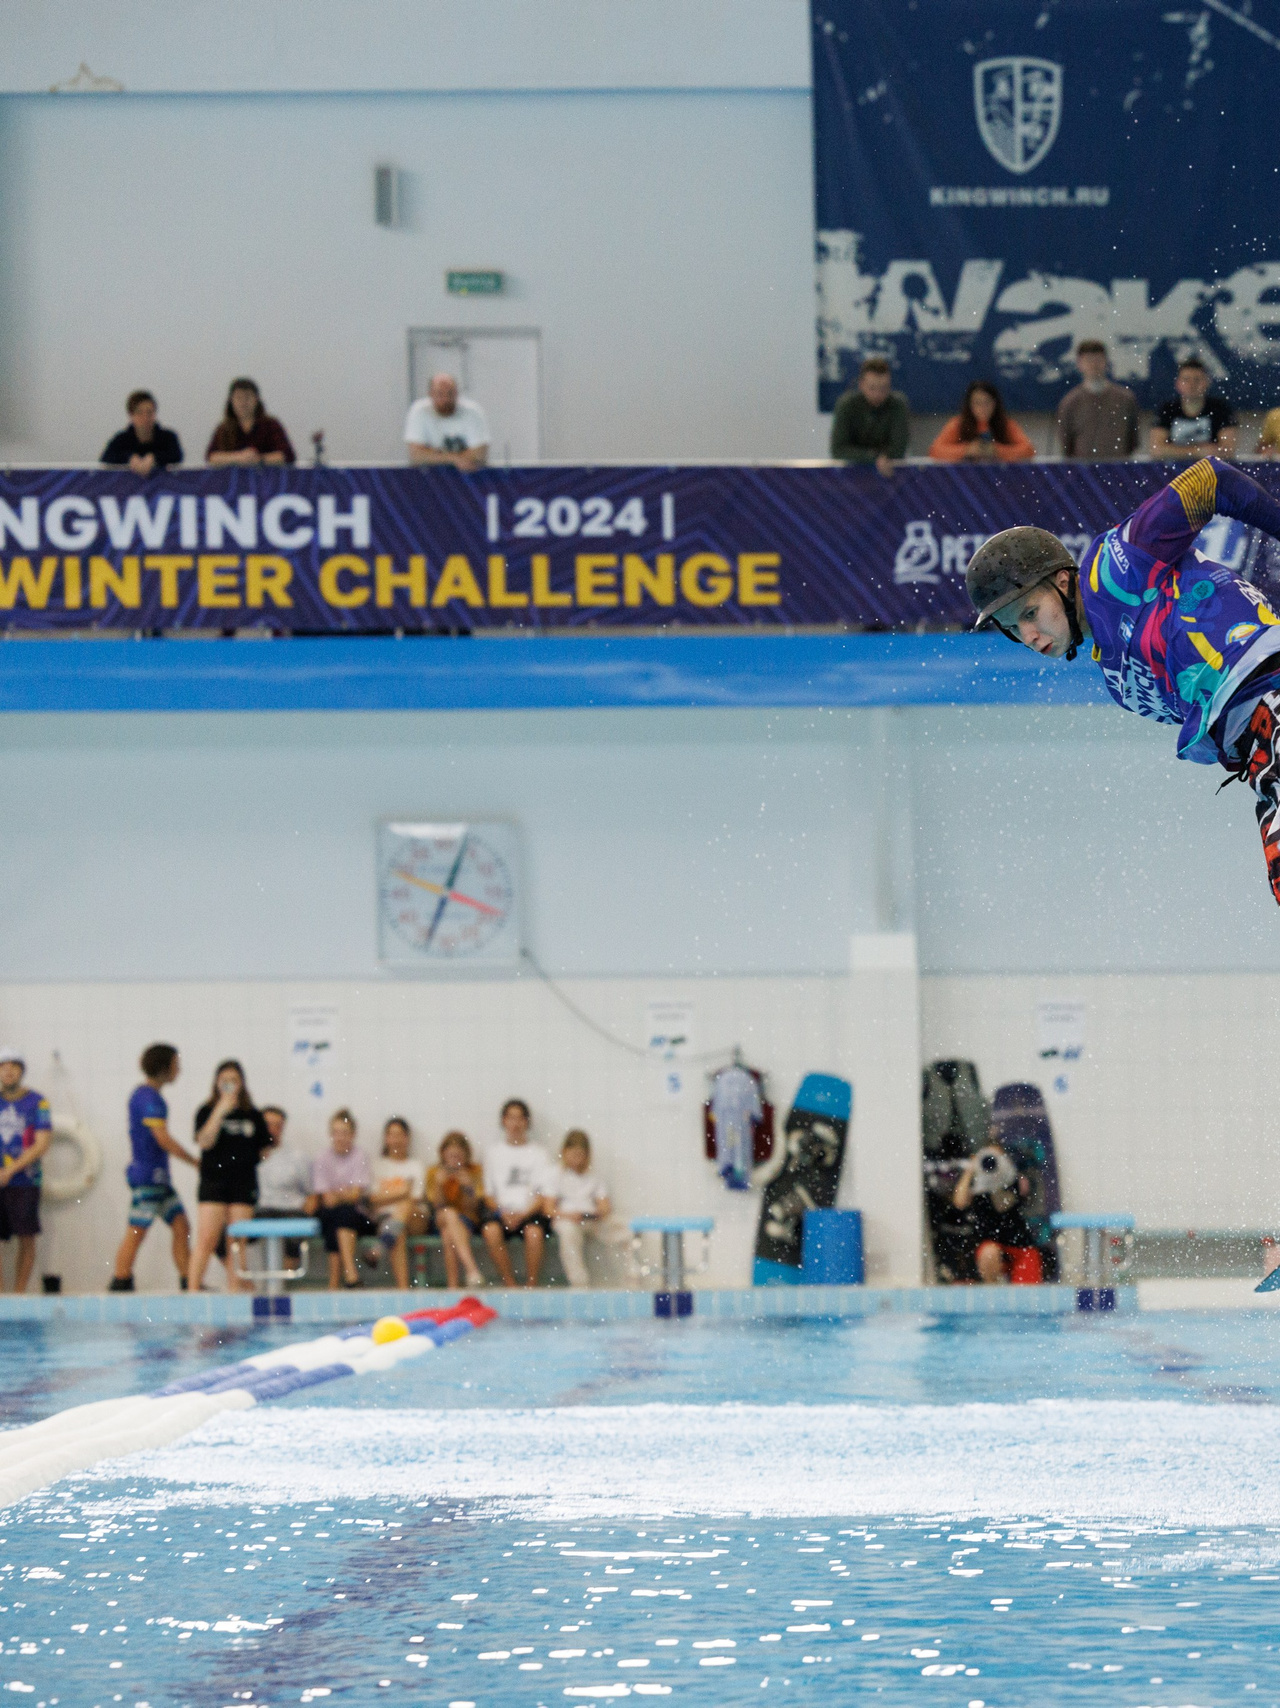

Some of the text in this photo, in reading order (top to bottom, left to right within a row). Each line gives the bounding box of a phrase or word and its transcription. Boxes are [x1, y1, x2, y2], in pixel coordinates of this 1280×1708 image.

[512, 496, 648, 537] 2024
[0, 552, 782, 609] WINTER CHALLENGE
